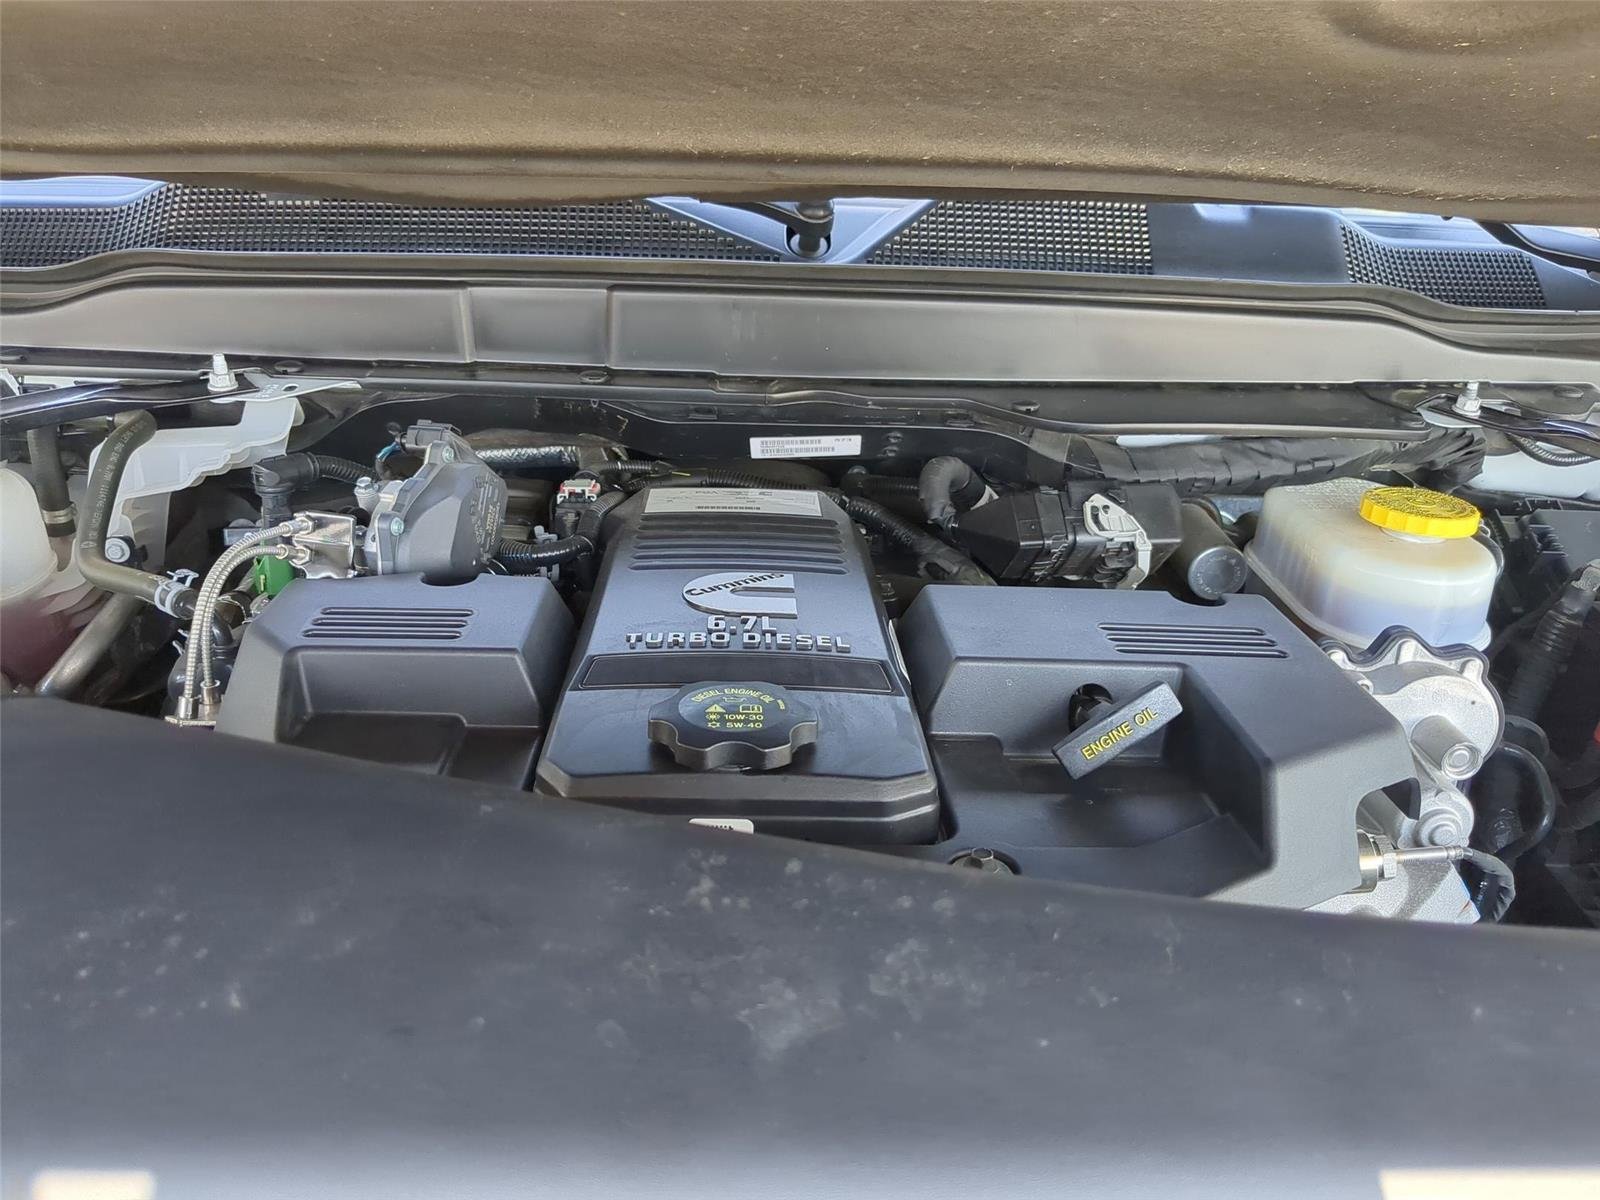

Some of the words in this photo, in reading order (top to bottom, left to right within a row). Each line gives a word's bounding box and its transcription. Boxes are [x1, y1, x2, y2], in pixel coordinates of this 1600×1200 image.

[684, 572, 785, 597] Cummins
[707, 614, 777, 635] 6.7L
[626, 631, 730, 649] TURBO
[742, 631, 851, 653] DIESEL
[691, 689, 723, 702] DIESEL
[724, 688, 761, 699] ENGINE
[760, 694, 775, 704] OIL
[724, 713, 764, 721] 10W-30
[726, 721, 763, 729] 5W-40
[1081, 721, 1134, 760] ENGINE
[1134, 706, 1159, 727] OIL
